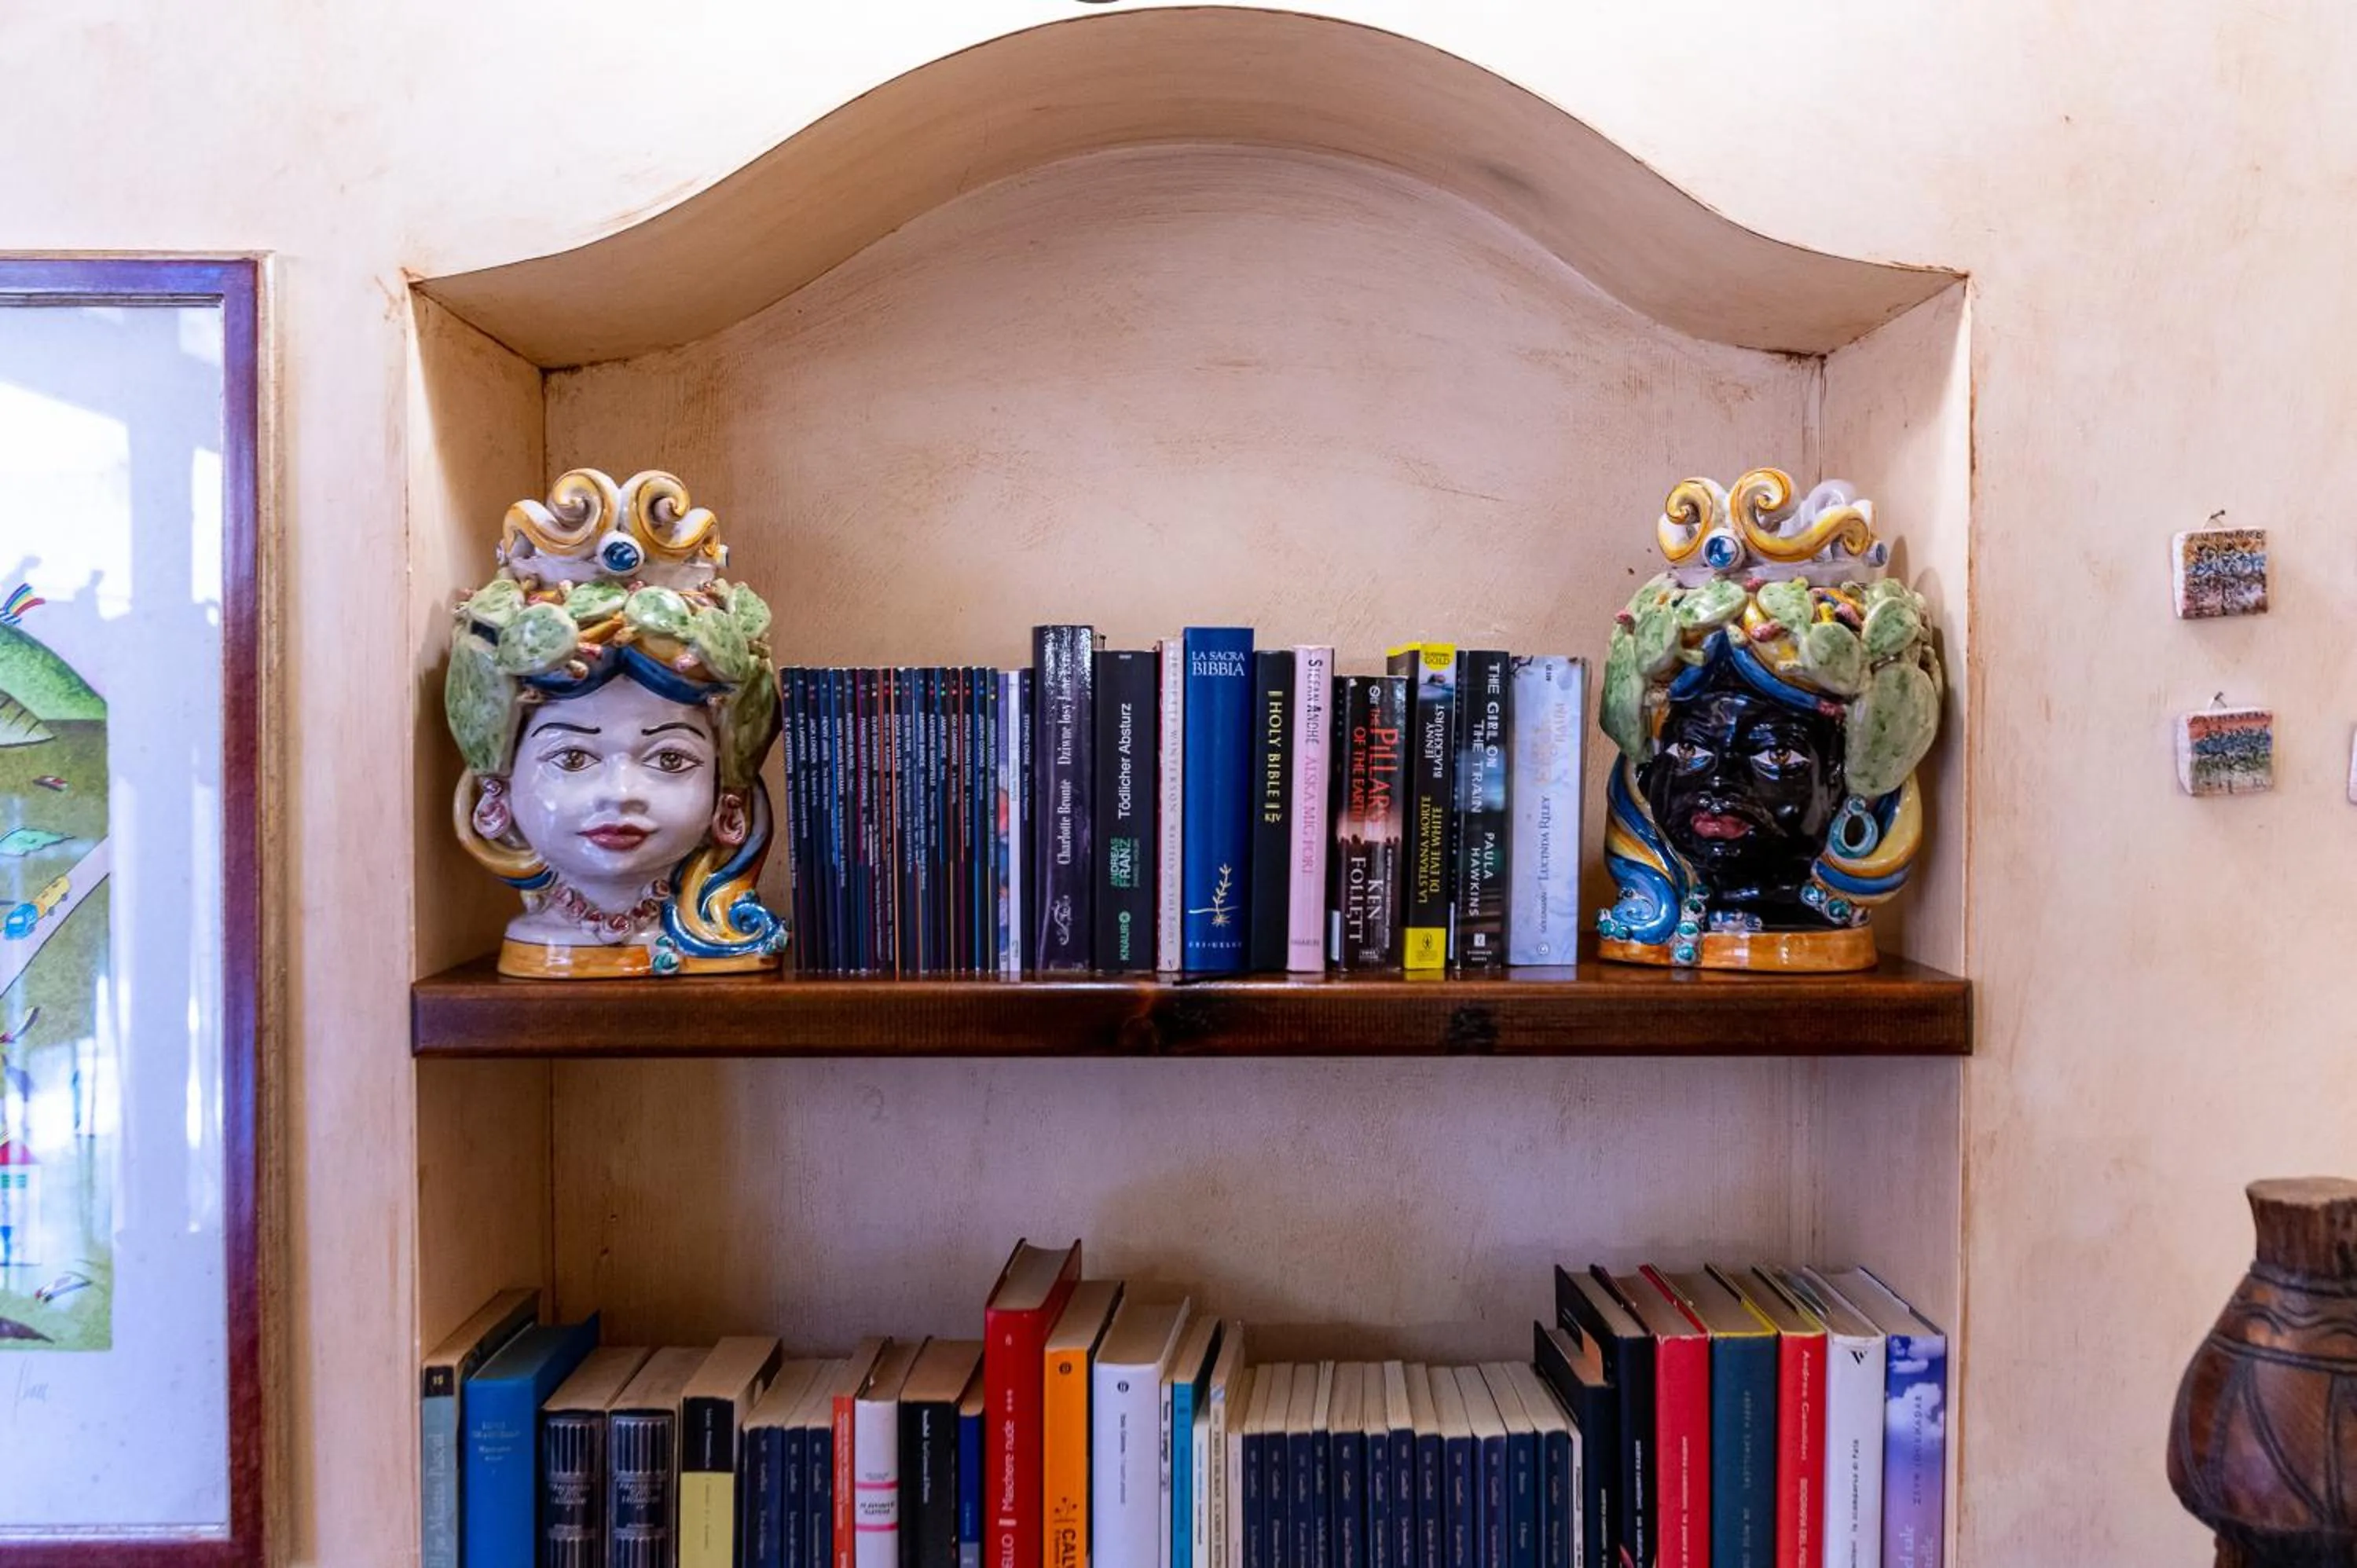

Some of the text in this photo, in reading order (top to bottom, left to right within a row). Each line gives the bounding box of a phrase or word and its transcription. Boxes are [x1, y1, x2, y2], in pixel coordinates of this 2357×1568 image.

[1191, 650, 1245, 661] LA SACRA
[1191, 661, 1245, 676] BIBBIA
[1306, 658, 1324, 702] STEFAN
[1057, 704, 1075, 724] losy
[1486, 662, 1500, 768] THE GIRL ON
[1057, 726, 1072, 765] Dziwne
[1118, 703, 1132, 819] Tödlicher Absturz
[1266, 701, 1283, 797] HOLY BIBLE
[1424, 722, 1435, 759] JENNY
[1433, 703, 1446, 779] BLACKHURST
[1351, 727, 1365, 822] OF THE EARTH
[1470, 719, 1485, 813] THE TRAIN
[1538, 794, 1551, 830] RILEY
[1057, 816, 1072, 865] Charlotte
[1109, 837, 1120, 887] ANDREAS
[1120, 837, 1132, 888] FRANZ
[1418, 795, 1431, 903] LA STRANA MORTE
[1430, 806, 1442, 892] DI EVIE WHITE
[1483, 831, 1495, 880] PAULA
[1538, 832, 1551, 881] LUCINDA
[1347, 855, 1366, 943] FOLLETT
[1367, 878, 1384, 920] KEN
[1468, 847, 1481, 918] HAWKINS
[1120, 921, 1130, 961] KNAUR
[1003, 1420, 1014, 1452] nude
[1002, 1453, 1014, 1512] Maschere
